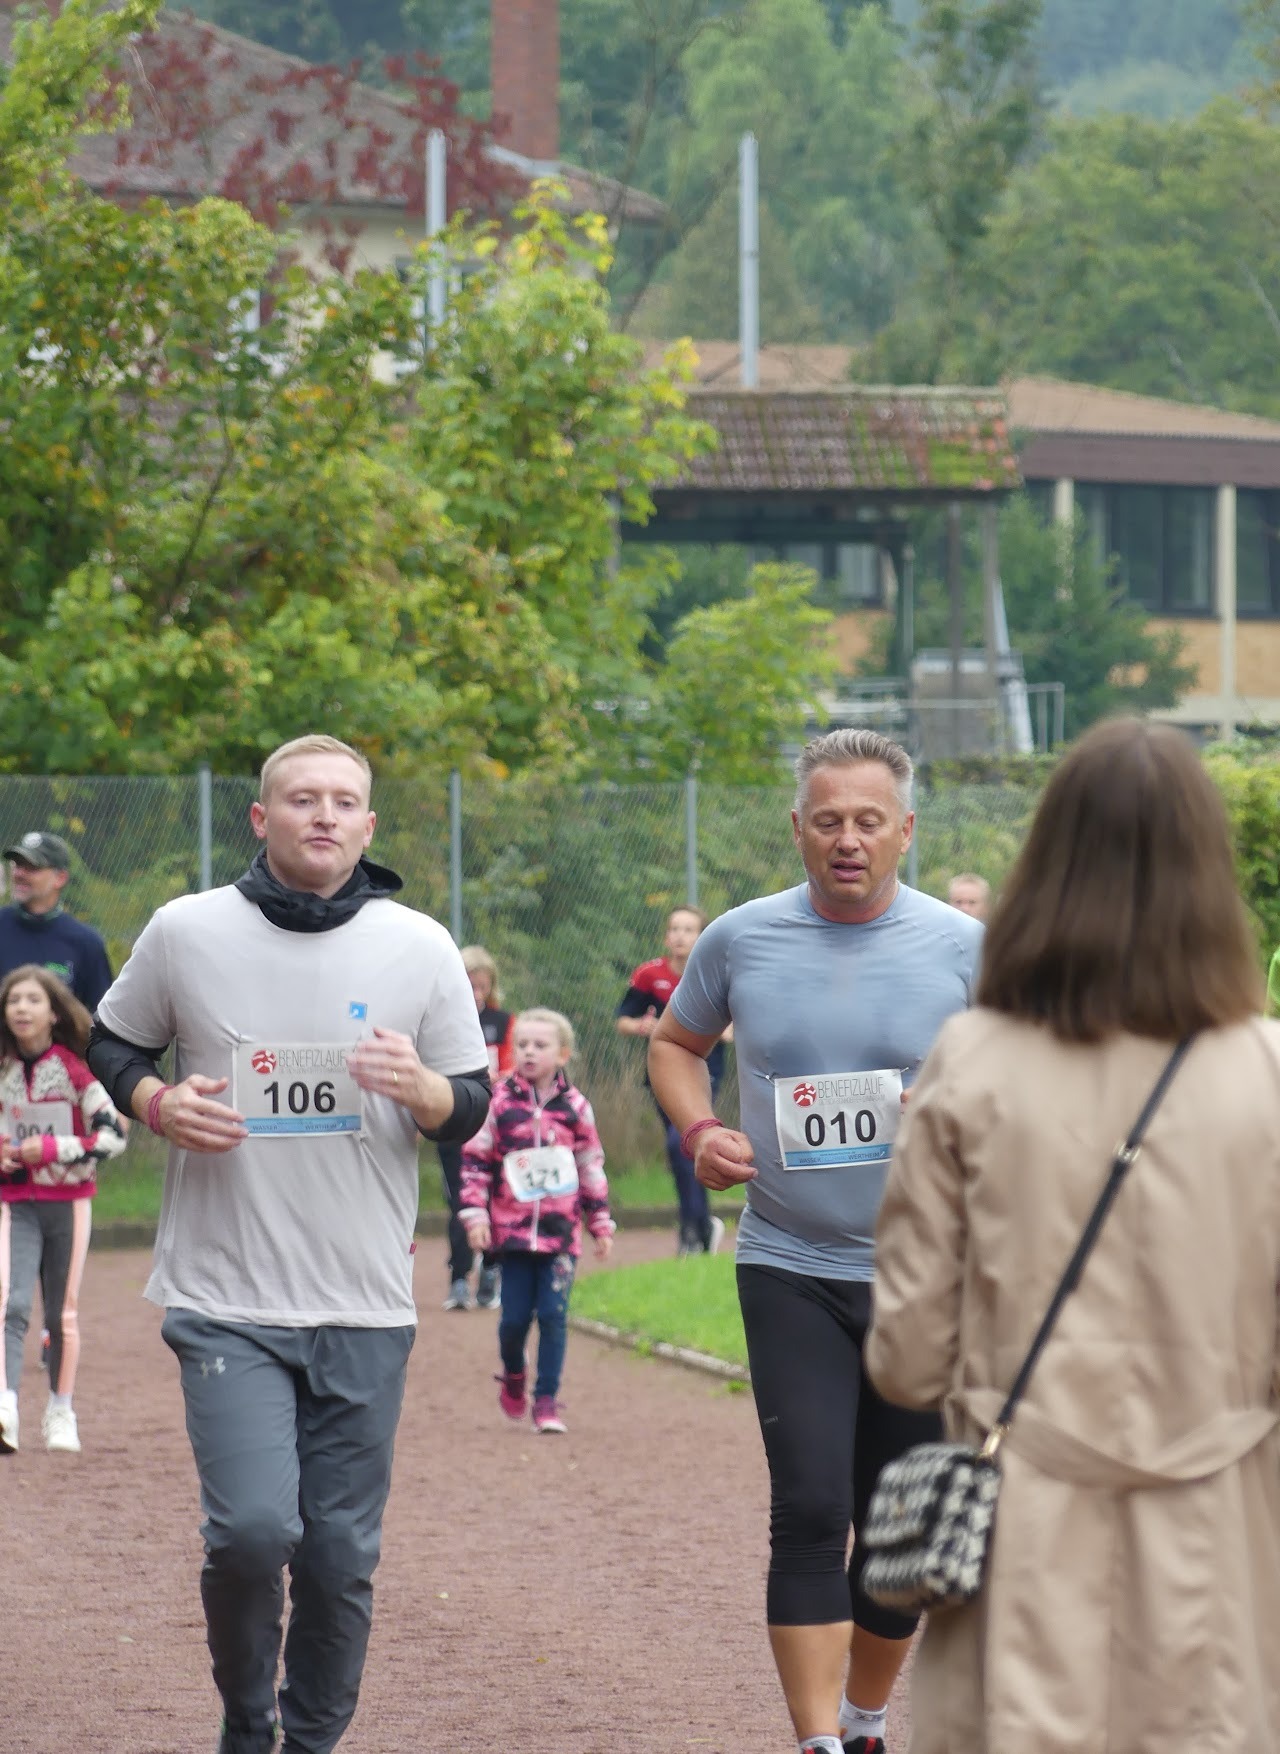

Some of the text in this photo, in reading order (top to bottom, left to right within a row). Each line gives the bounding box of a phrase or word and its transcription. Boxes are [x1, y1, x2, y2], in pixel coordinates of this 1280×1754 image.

[278, 1049, 346, 1067] BENEFIZLAUF
[263, 1081, 336, 1114] 106
[817, 1076, 884, 1099] BENEFIZLAUF
[804, 1109, 876, 1146] 010
[848, 1151, 880, 1160] WERTHEIM
